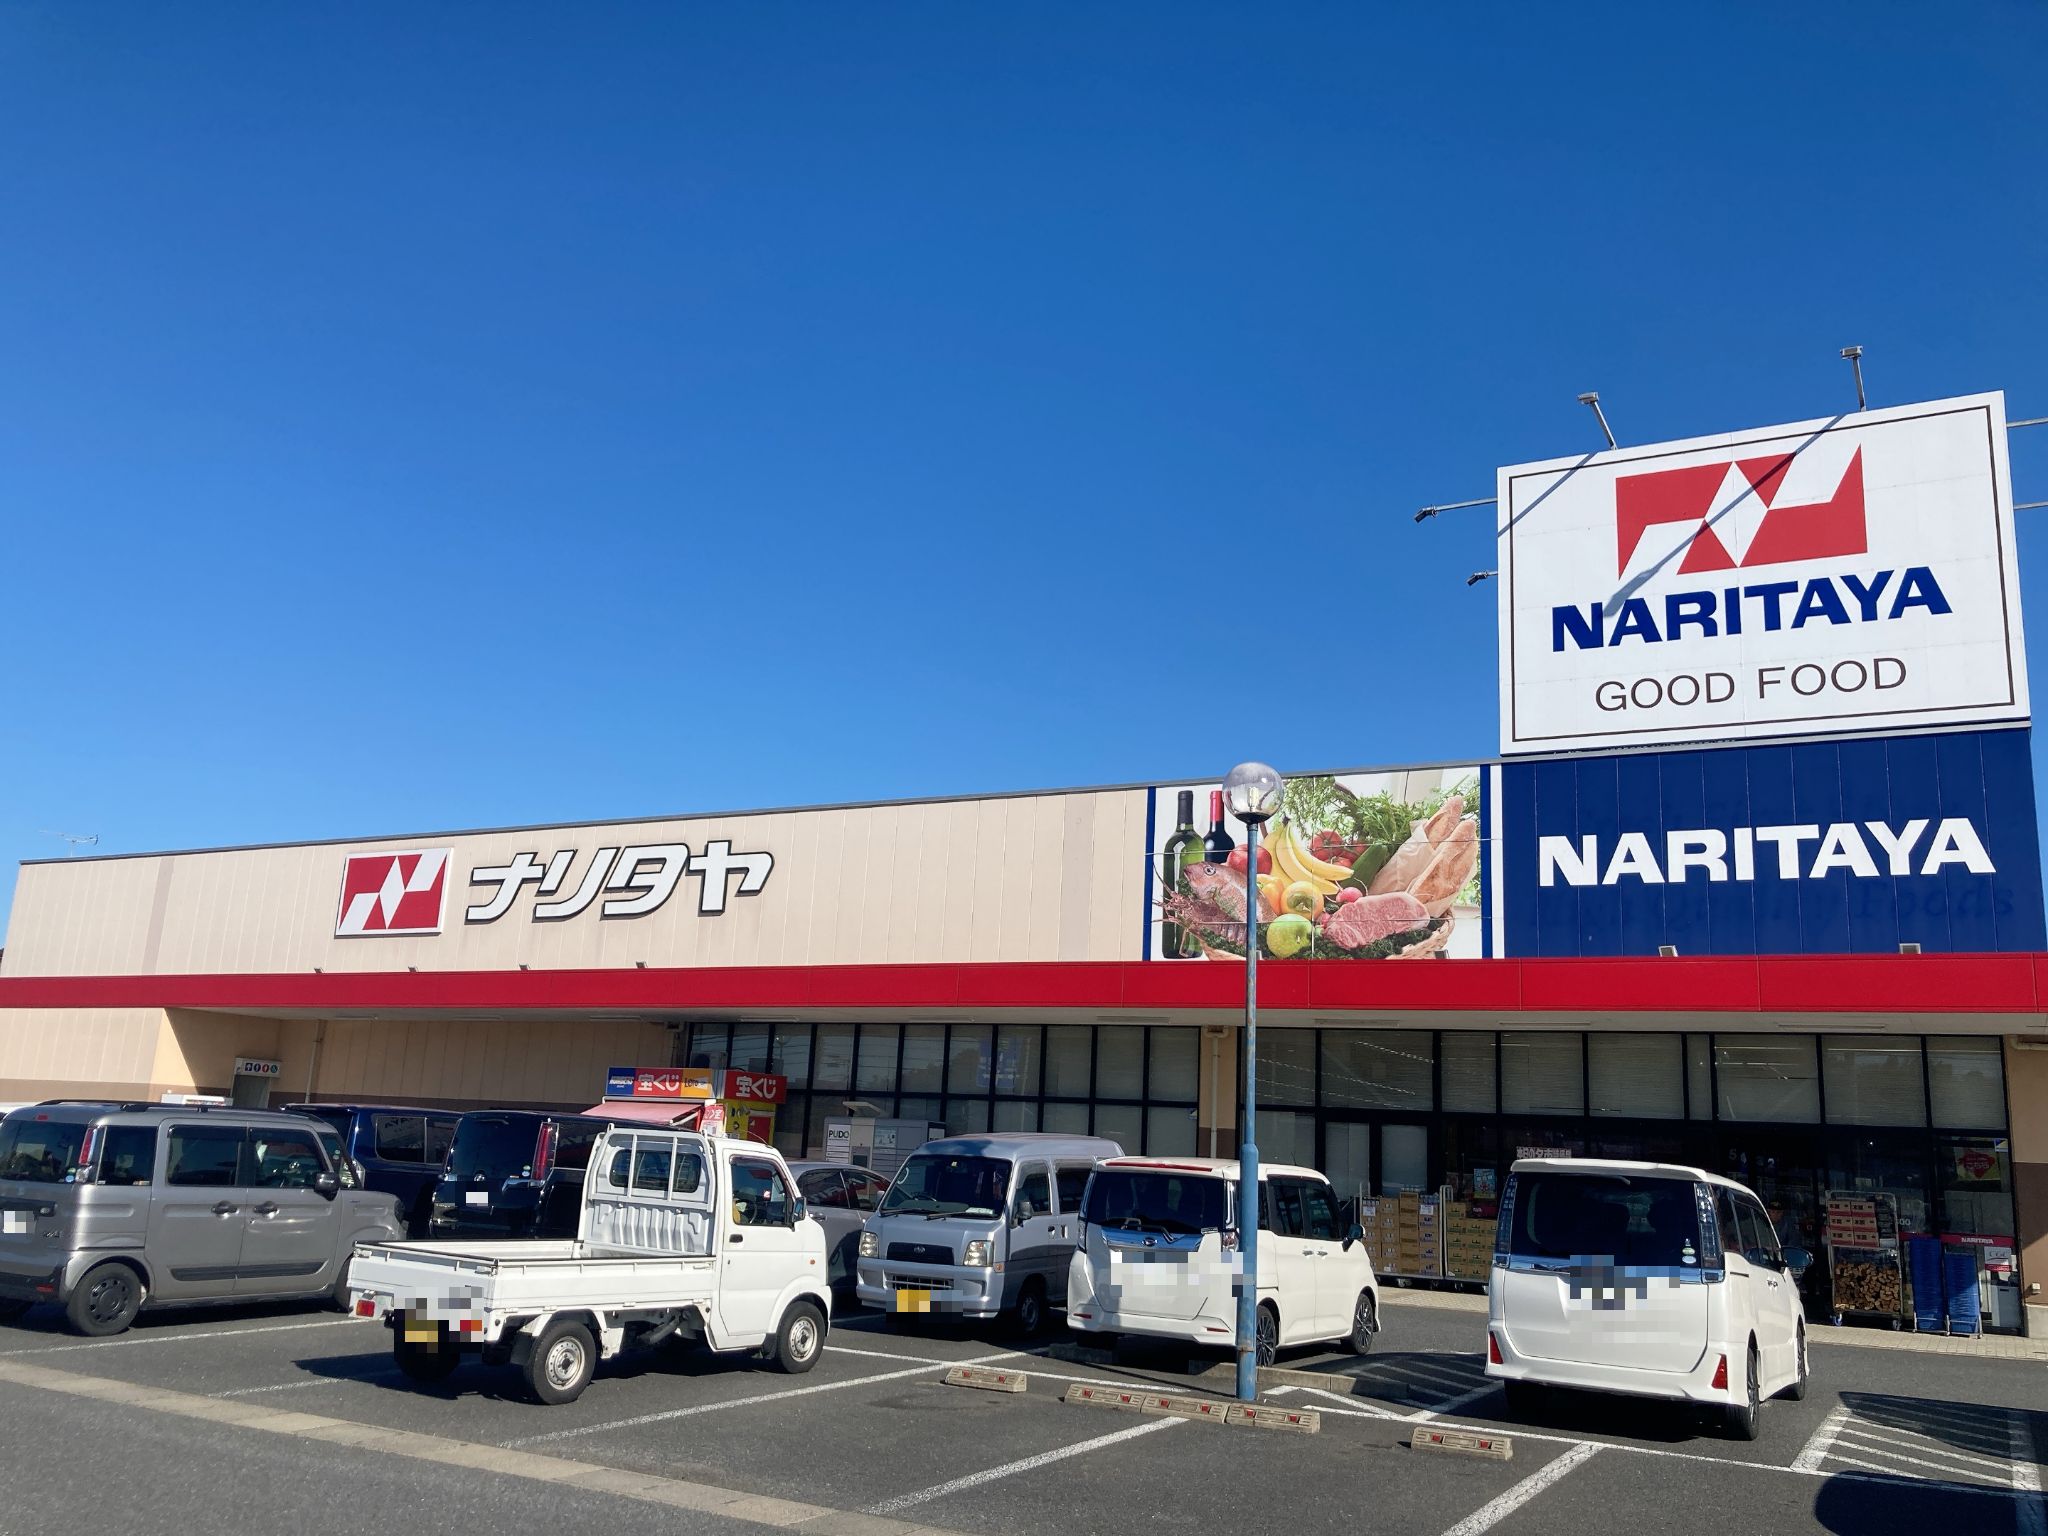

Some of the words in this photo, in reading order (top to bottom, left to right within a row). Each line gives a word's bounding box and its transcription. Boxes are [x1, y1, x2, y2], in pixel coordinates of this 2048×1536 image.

[1552, 566, 1953, 652] NARITAYA
[1595, 672, 1735, 712] GOOD
[1758, 657, 1907, 700] FOOD
[1538, 817, 1997, 887] NARITAYA
[464, 839, 775, 925] ナリタヤ
[637, 1073, 680, 1092] 宝くじ
[736, 1075, 776, 1099] 宝くじ
[828, 1130, 850, 1139] PUDO
